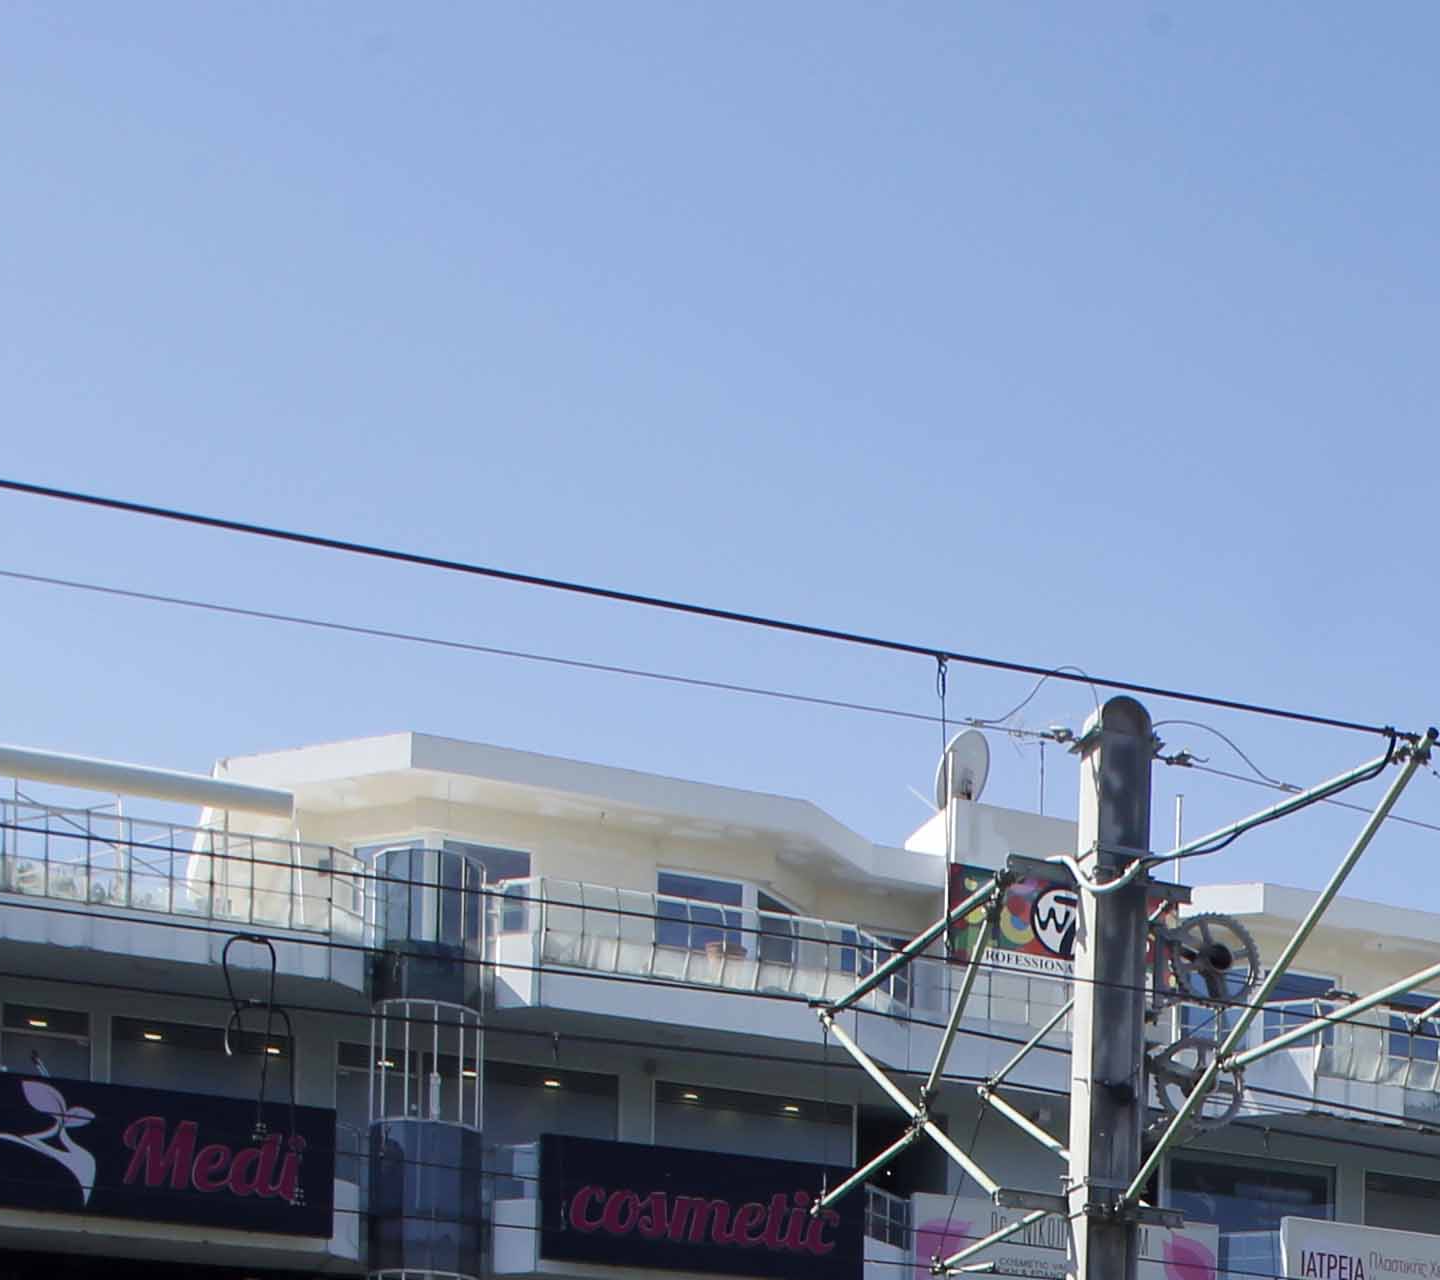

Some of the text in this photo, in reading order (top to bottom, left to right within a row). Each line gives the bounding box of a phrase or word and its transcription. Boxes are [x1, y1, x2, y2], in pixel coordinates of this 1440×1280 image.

[985, 951, 1074, 975] ROFESSIONA
[122, 1115, 305, 1203] Medi
[569, 1183, 840, 1256] cosmetic
